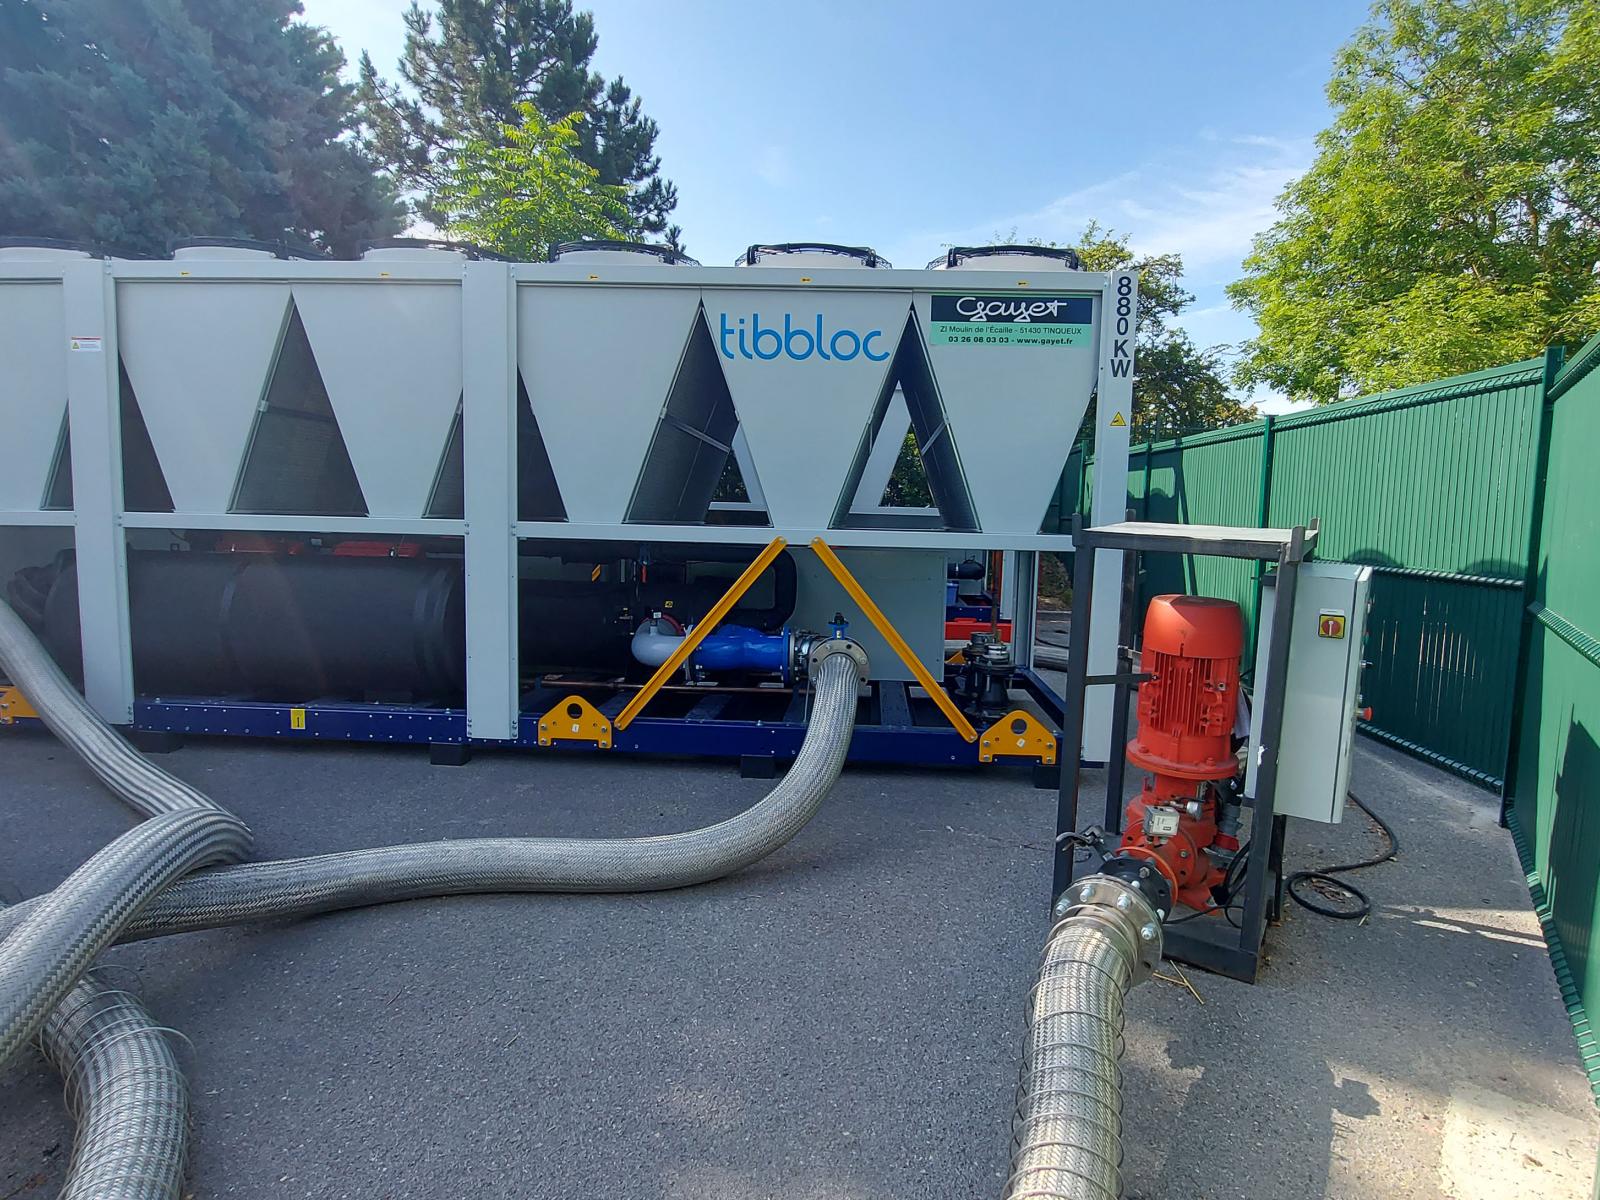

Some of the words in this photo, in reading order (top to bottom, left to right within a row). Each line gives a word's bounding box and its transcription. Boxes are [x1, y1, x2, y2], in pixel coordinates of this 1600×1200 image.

[956, 297, 1067, 322] Gayet
[720, 313, 890, 361] tibbloc
[940, 325, 947, 333] ZI
[985, 325, 1013, 334] l'Écaille
[1043, 327, 1082, 335] TINQUEUX
[1016, 337, 1073, 346] www.gayet.fr
